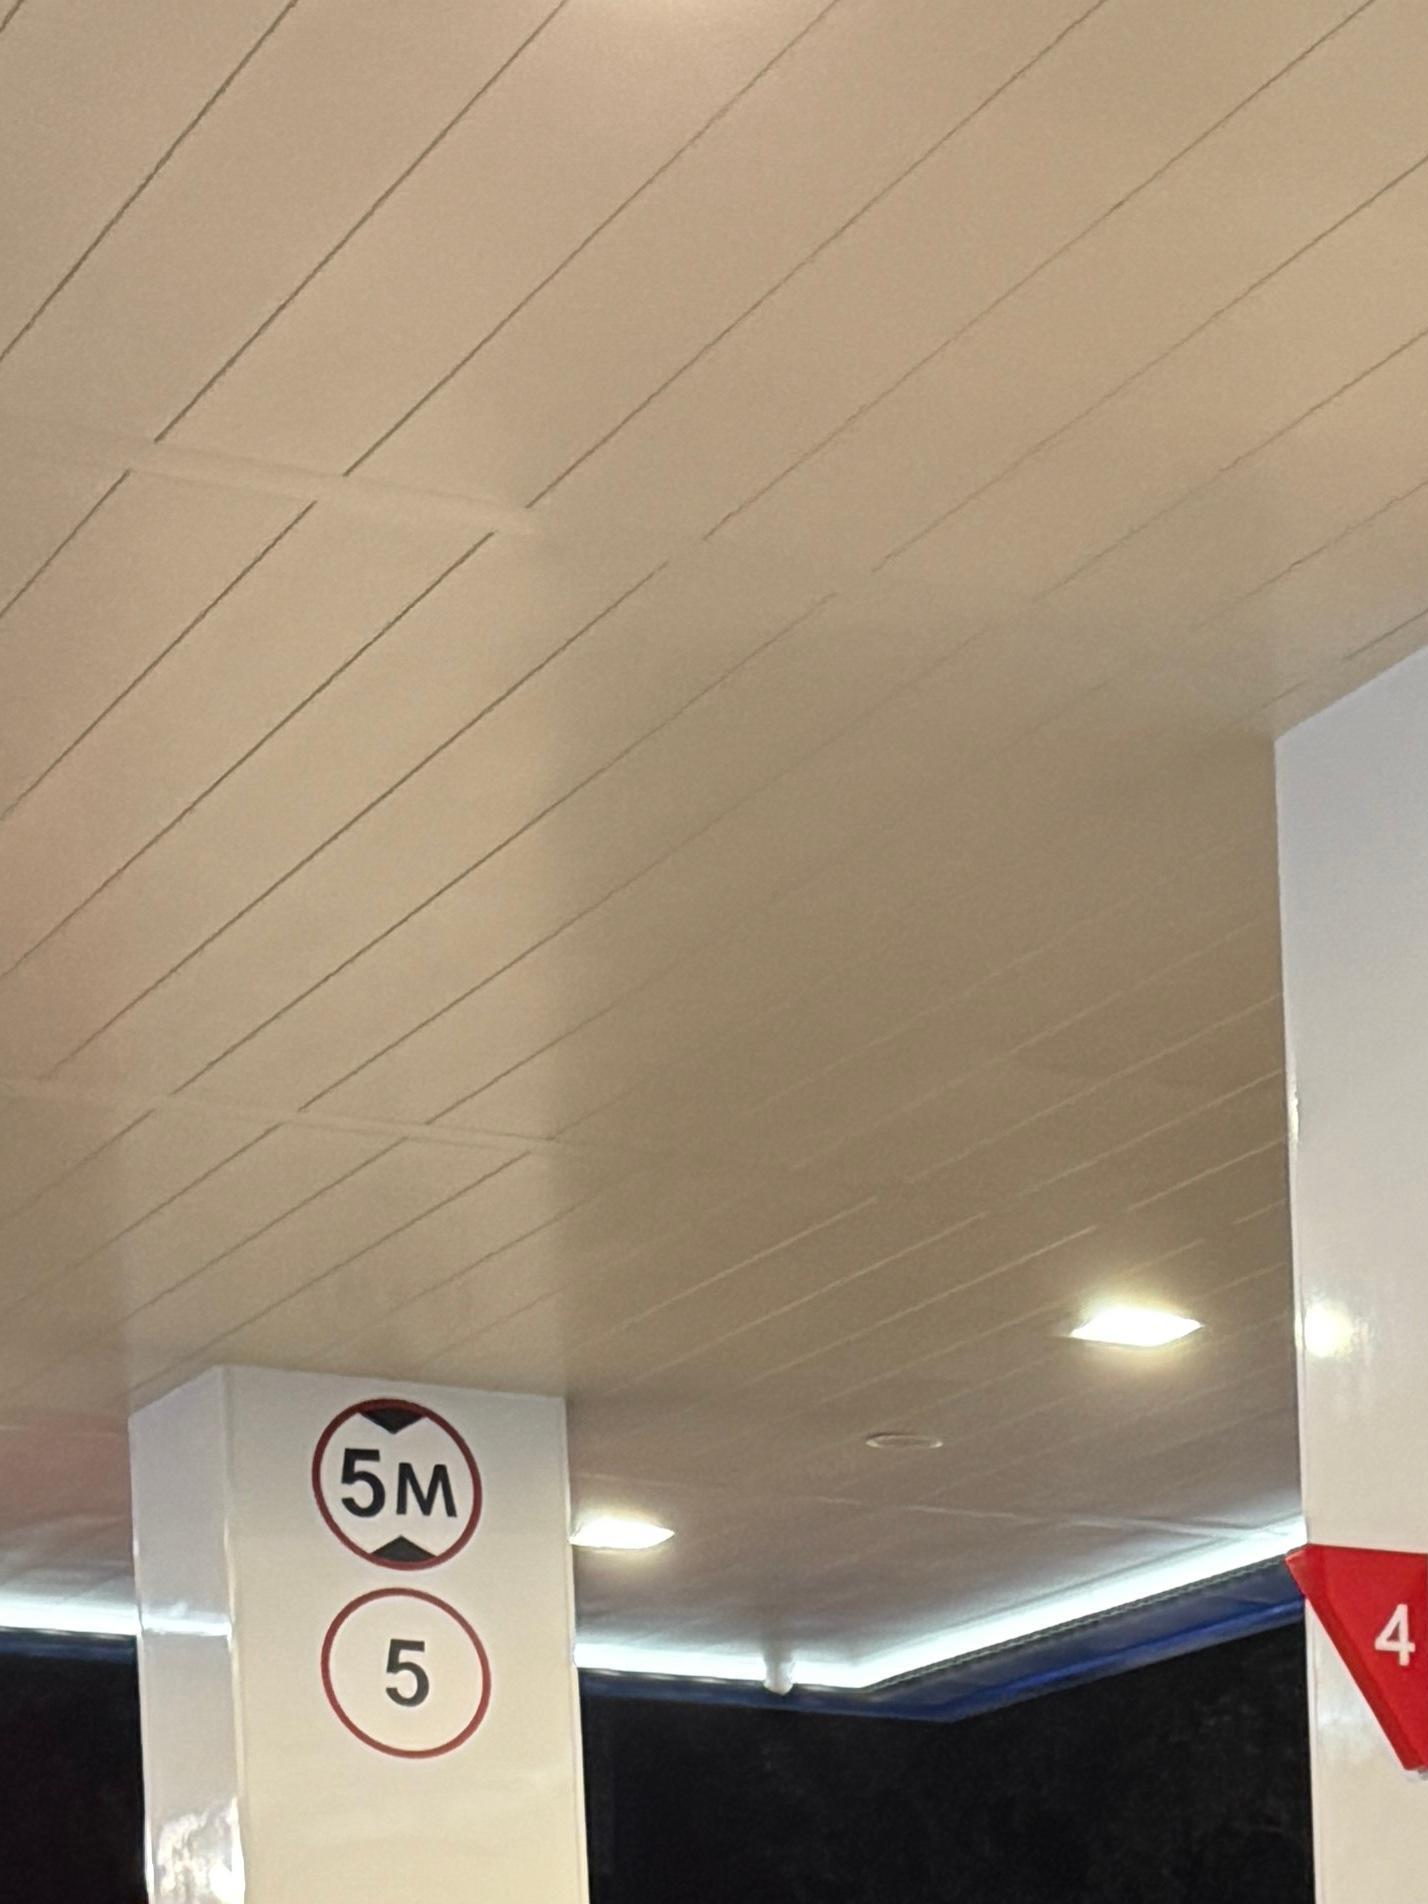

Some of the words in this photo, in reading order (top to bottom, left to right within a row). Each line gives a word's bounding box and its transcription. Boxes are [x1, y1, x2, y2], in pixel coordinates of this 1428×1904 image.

[340, 1447, 457, 1518] 5M
[1374, 1603, 1416, 1667] 4
[385, 1639, 430, 1708] 5
